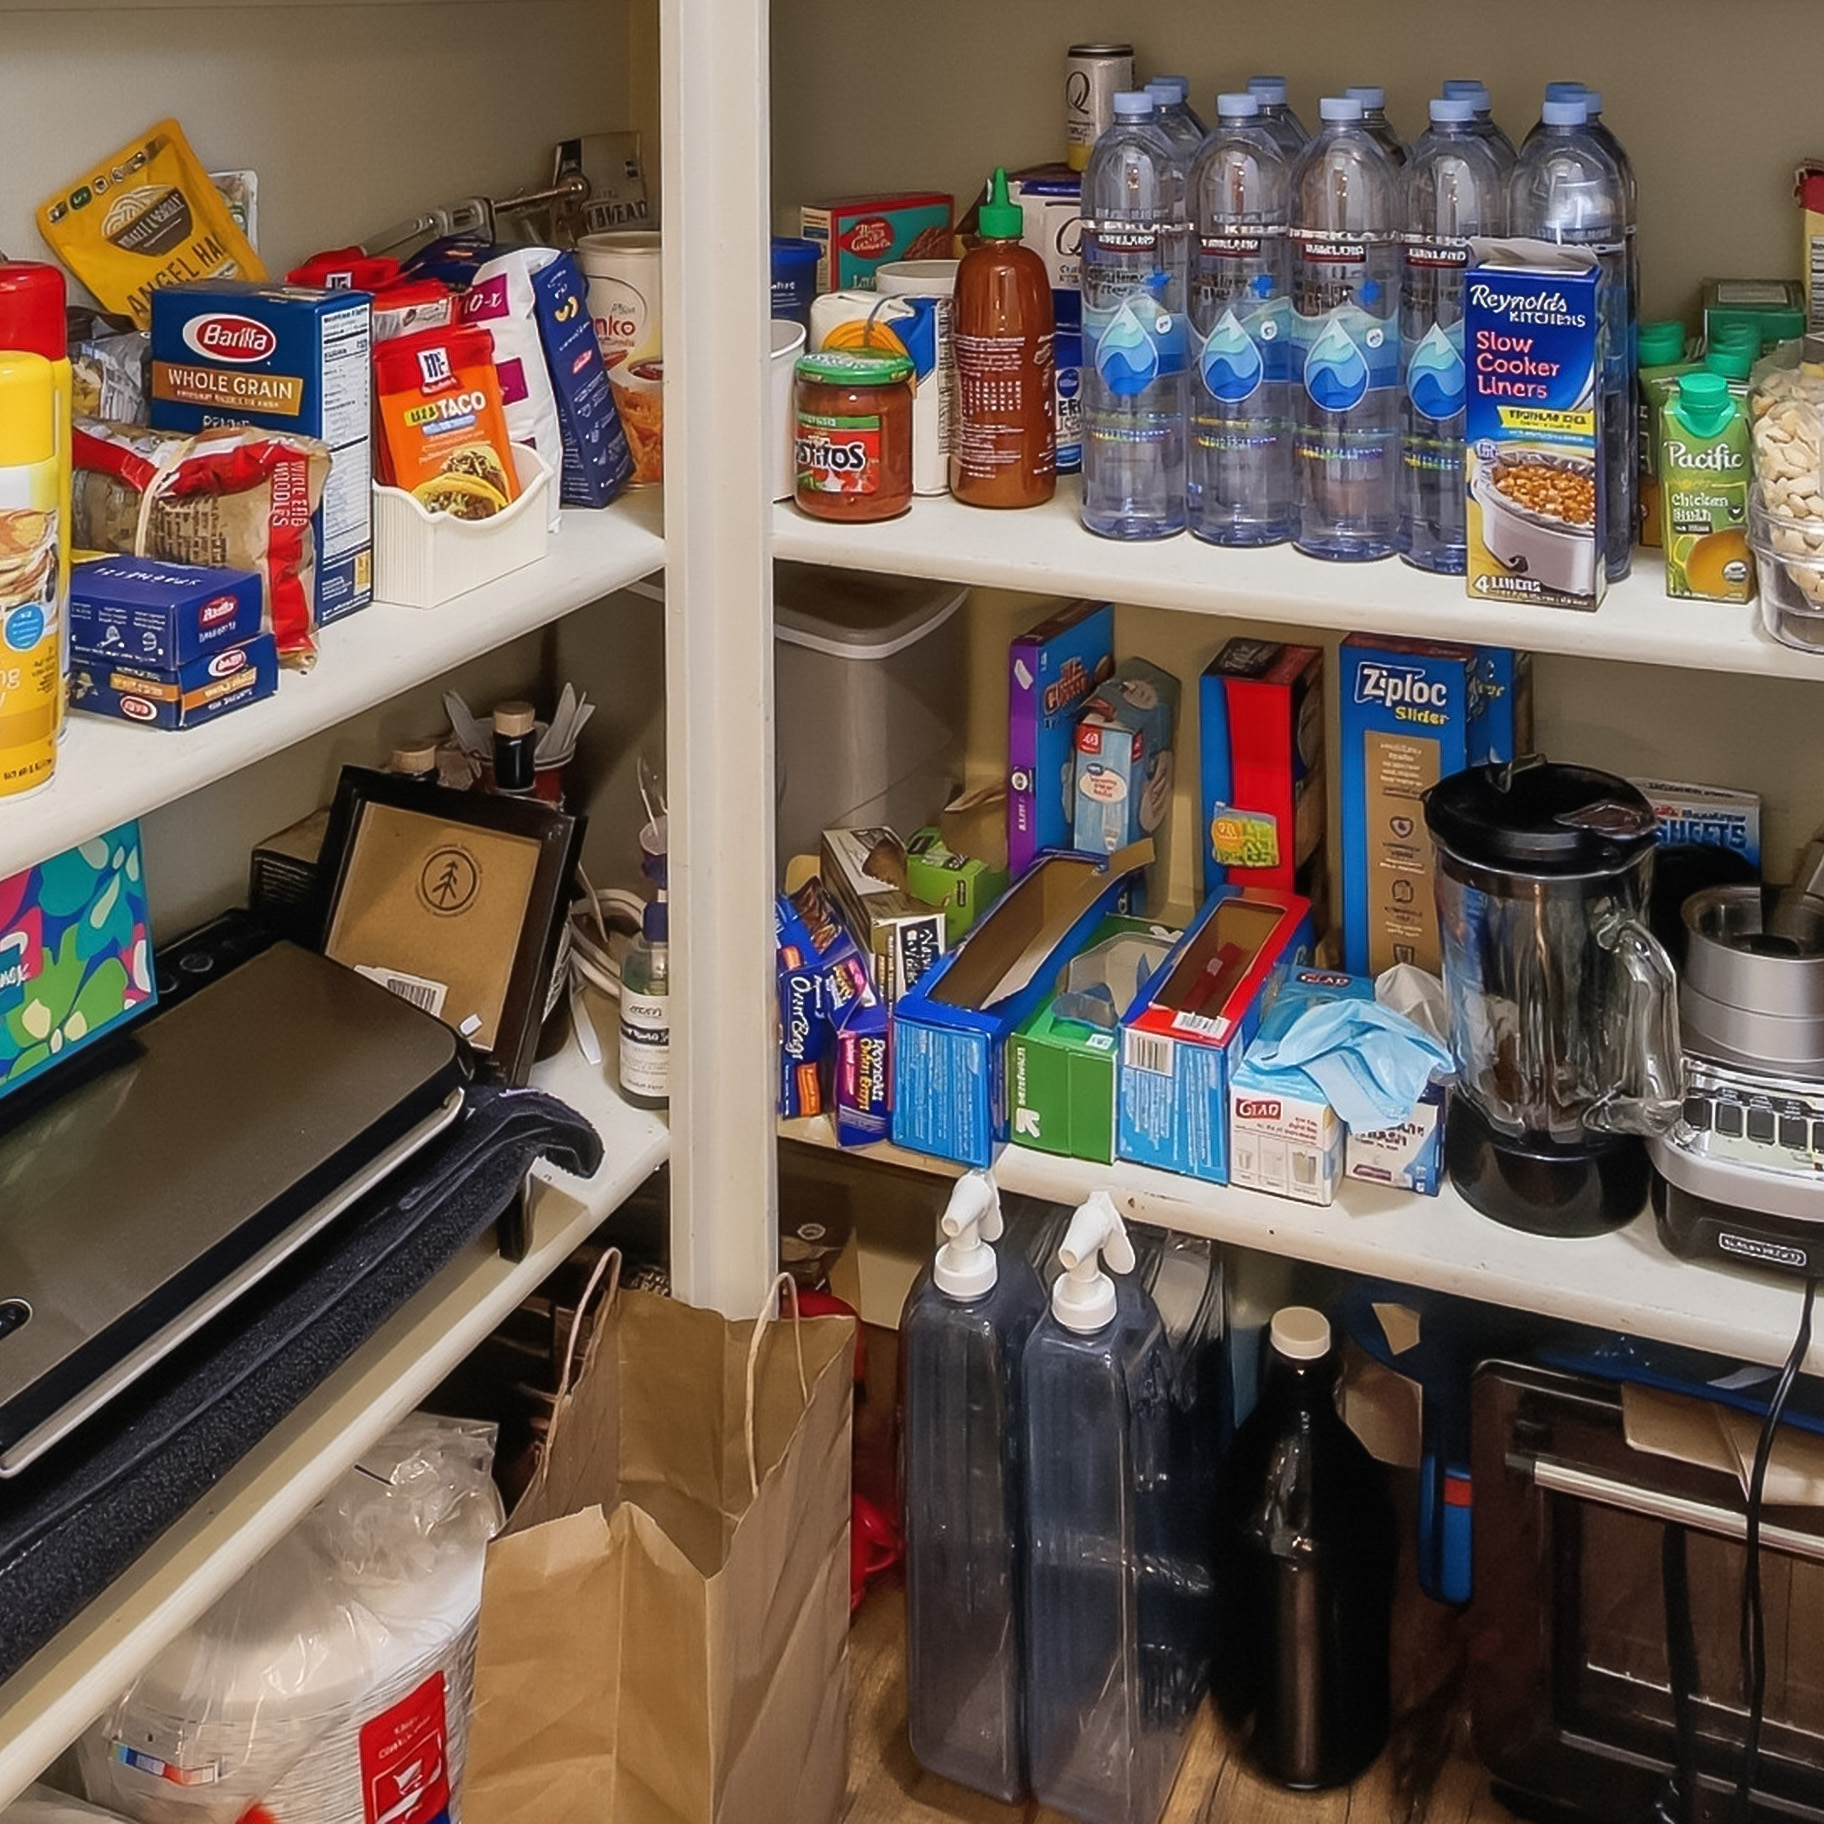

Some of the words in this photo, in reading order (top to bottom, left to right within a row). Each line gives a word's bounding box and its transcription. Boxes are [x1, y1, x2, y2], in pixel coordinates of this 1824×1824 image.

[1470, 284, 1567, 315] Reynolds
[202, 322, 269, 350] Barilla
[1476, 331, 1533, 354] Slow
[1476, 352, 1560, 375] Cooker
[167, 368, 230, 395] WHOLE
[232, 373, 294, 400] GRAIN
[438, 390, 486, 418] TACO
[1667, 439, 1744, 471] Pacific
[1671, 492, 1729, 509] Chicken
[1474, 574, 1489, 594] 4
[1358, 664, 1448, 709] Ziploc
